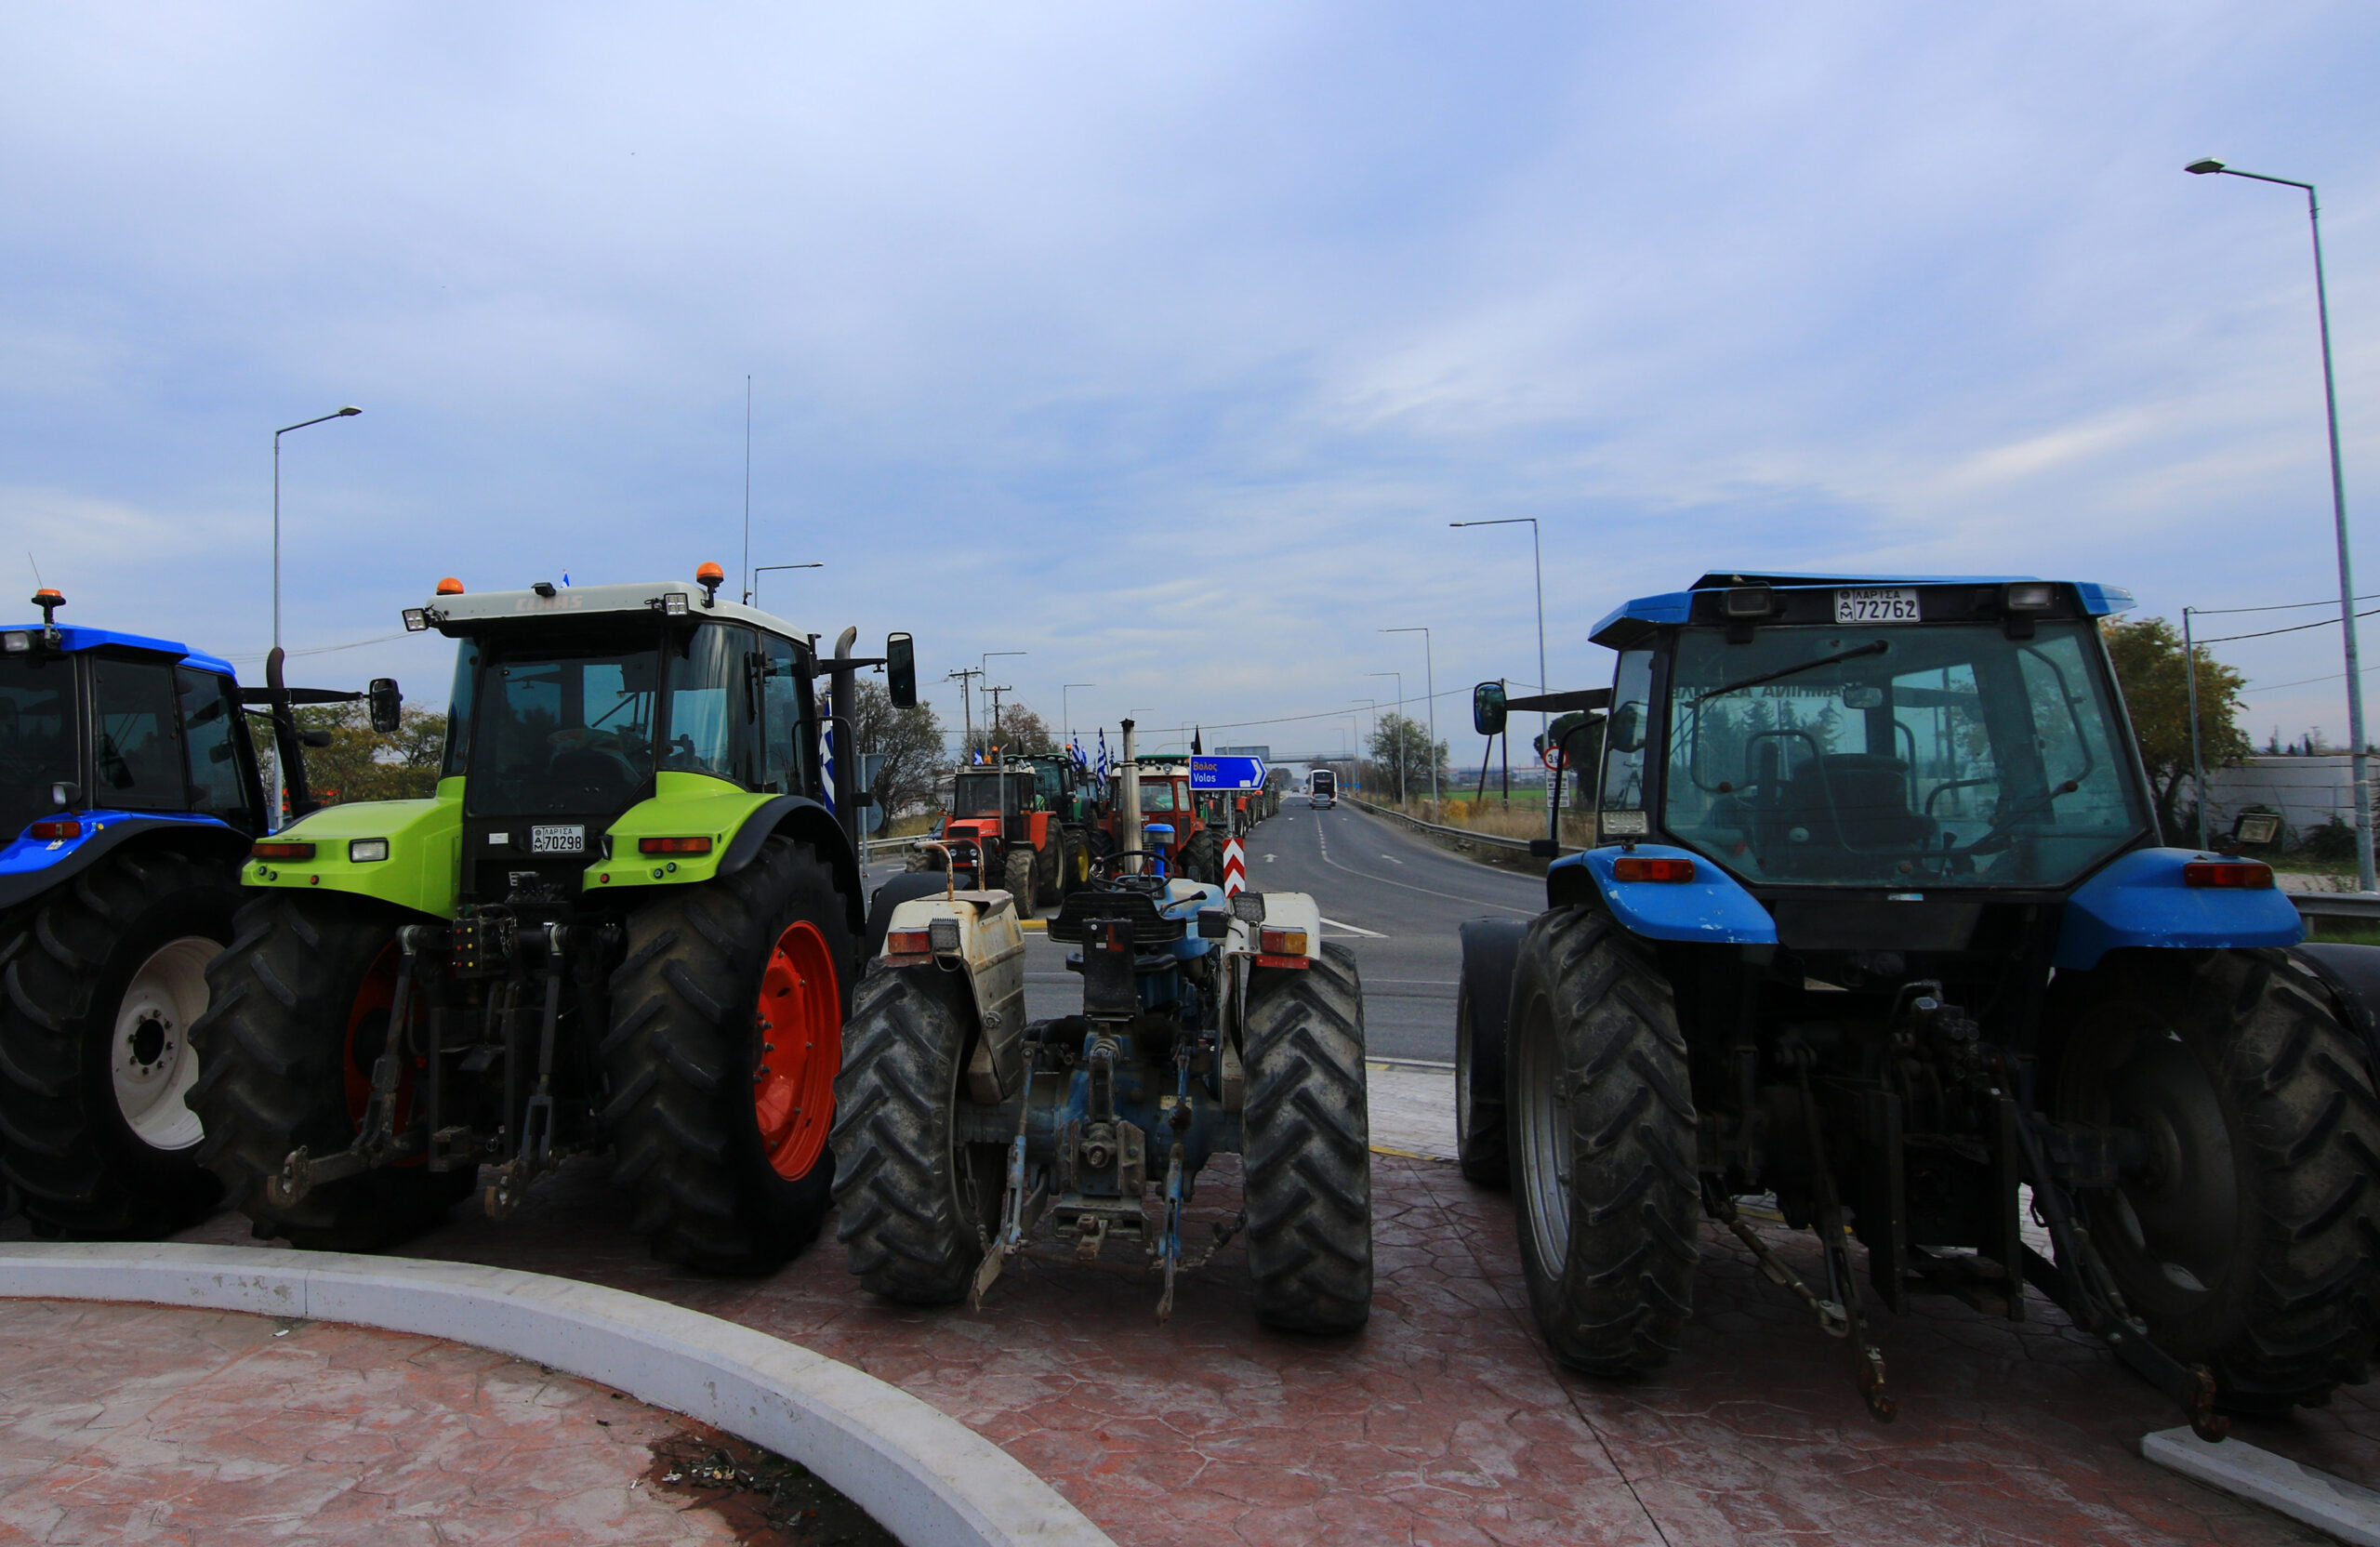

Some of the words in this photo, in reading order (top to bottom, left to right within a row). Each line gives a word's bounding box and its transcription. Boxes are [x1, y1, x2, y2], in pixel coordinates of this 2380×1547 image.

[1856, 590, 1900, 600] ΛΑΡΙΣΑ
[1857, 600, 1916, 619] 72762
[1193, 760, 1218, 772] Βόλος
[1193, 773, 1217, 783] Volos
[545, 836, 582, 850] 70298
